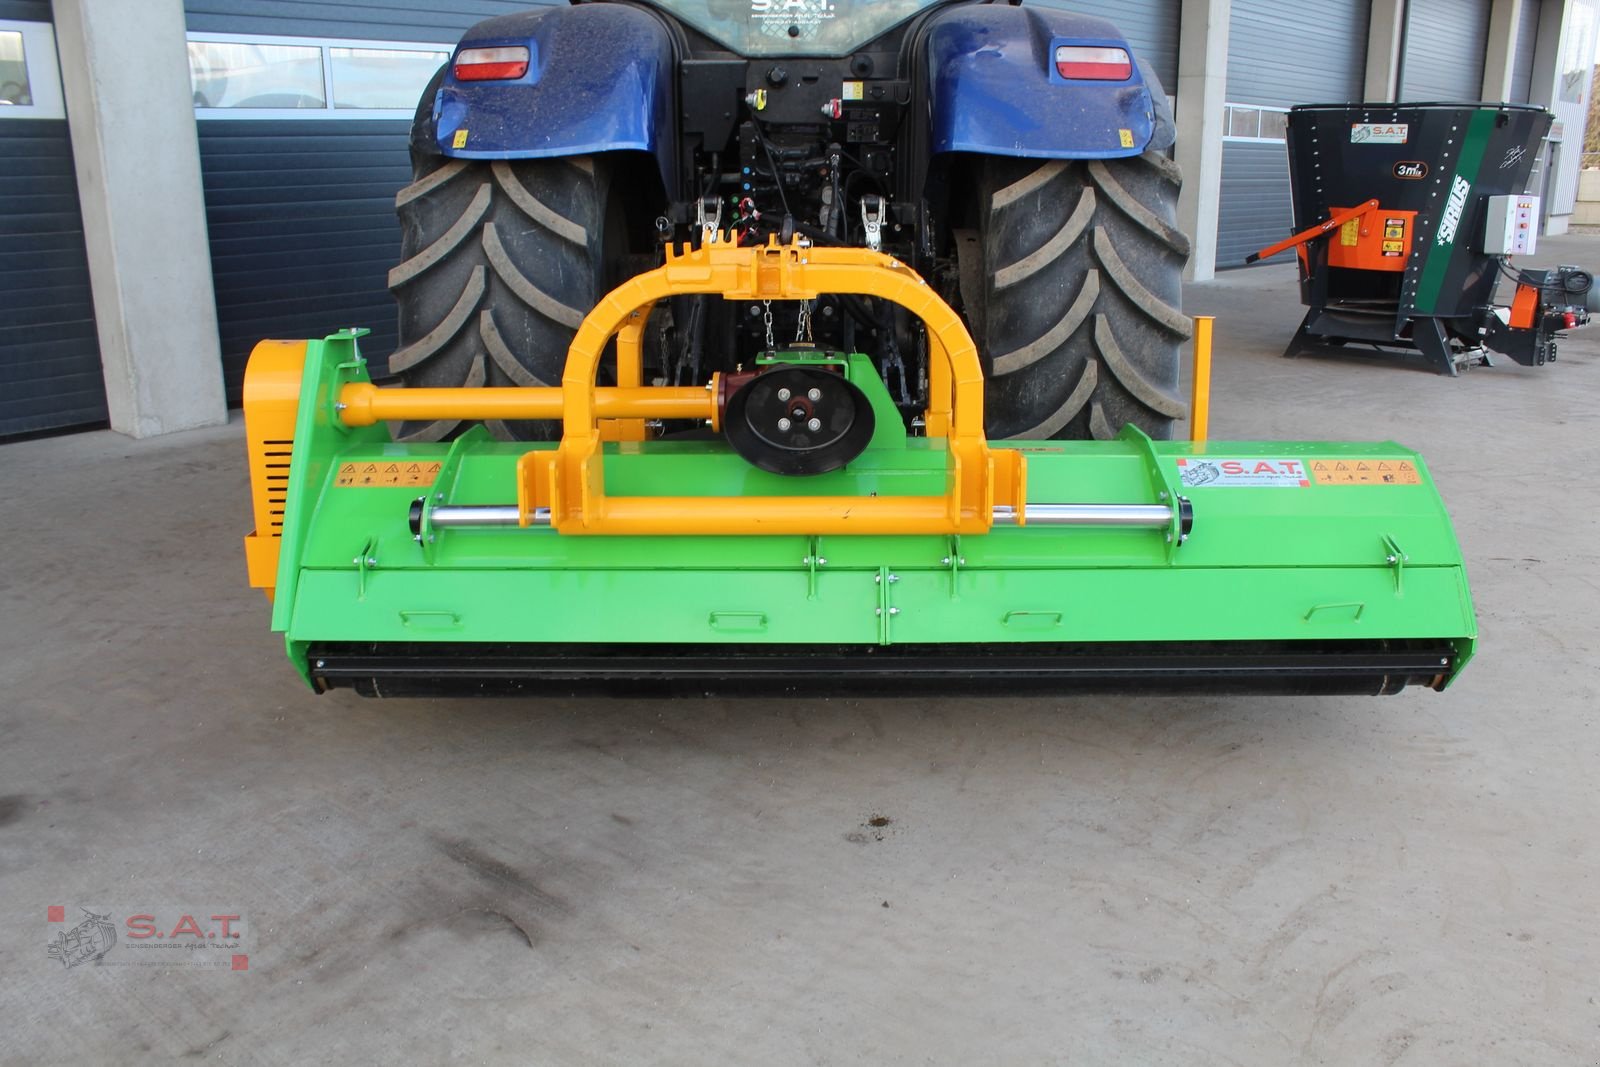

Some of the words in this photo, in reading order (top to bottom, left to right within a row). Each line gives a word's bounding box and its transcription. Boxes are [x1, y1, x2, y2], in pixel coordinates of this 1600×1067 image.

[1373, 126, 1406, 135] S.A.T.
[1441, 174, 1469, 244] SIRIUS
[1221, 461, 1302, 474] S.A.T.
